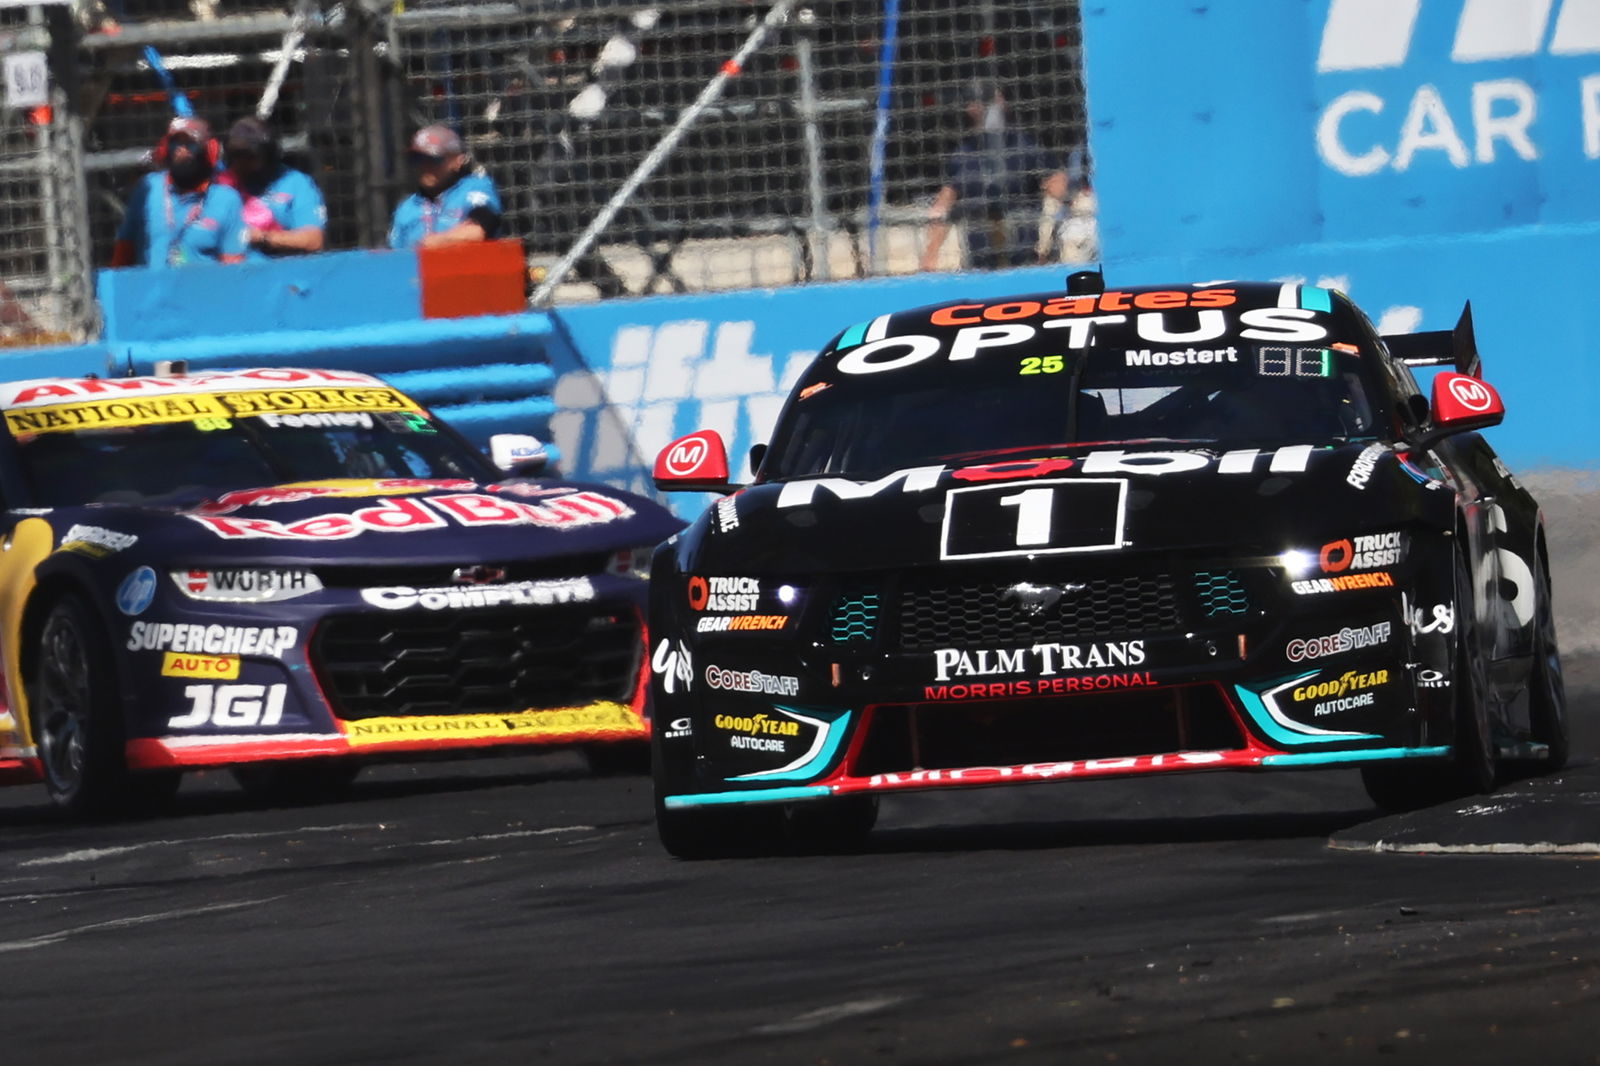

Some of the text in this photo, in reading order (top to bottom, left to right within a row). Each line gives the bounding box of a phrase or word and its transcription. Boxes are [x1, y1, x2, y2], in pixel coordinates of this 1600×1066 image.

[1316, 78, 1539, 177] CAR
[931, 288, 1236, 326] coates
[837, 308, 1326, 374] OPTUS
[1020, 355, 1063, 376] 25
[1125, 347, 1238, 366] Mostert
[8, 389, 402, 430] NATIONAL STORAGE
[260, 412, 373, 429] Feeney
[777, 445, 1314, 508] Mobil
[187, 498, 448, 540] Red
[423, 490, 637, 530] Bull
[1000, 488, 1054, 546] 1
[1353, 532, 1401, 552] TRUCK
[1350, 548, 1401, 570] ASSIST
[708, 577, 760, 594] TRUCK
[1291, 572, 1394, 595] GEARWRENCH
[706, 594, 760, 611] ASSIST
[697, 615, 788, 633] GEARWRENCH
[127, 620, 298, 659] SUPERCHEAP
[171, 658, 231, 673] AUTO
[934, 640, 1146, 682] PALM TRANS
[925, 672, 1158, 700] MORRIS PERSONAL
[168, 683, 288, 728] JGI
[1314, 693, 1375, 717] AUTOCARE
[353, 718, 500, 737] NATIONAL
[731, 735, 785, 752] AUTOCARE
